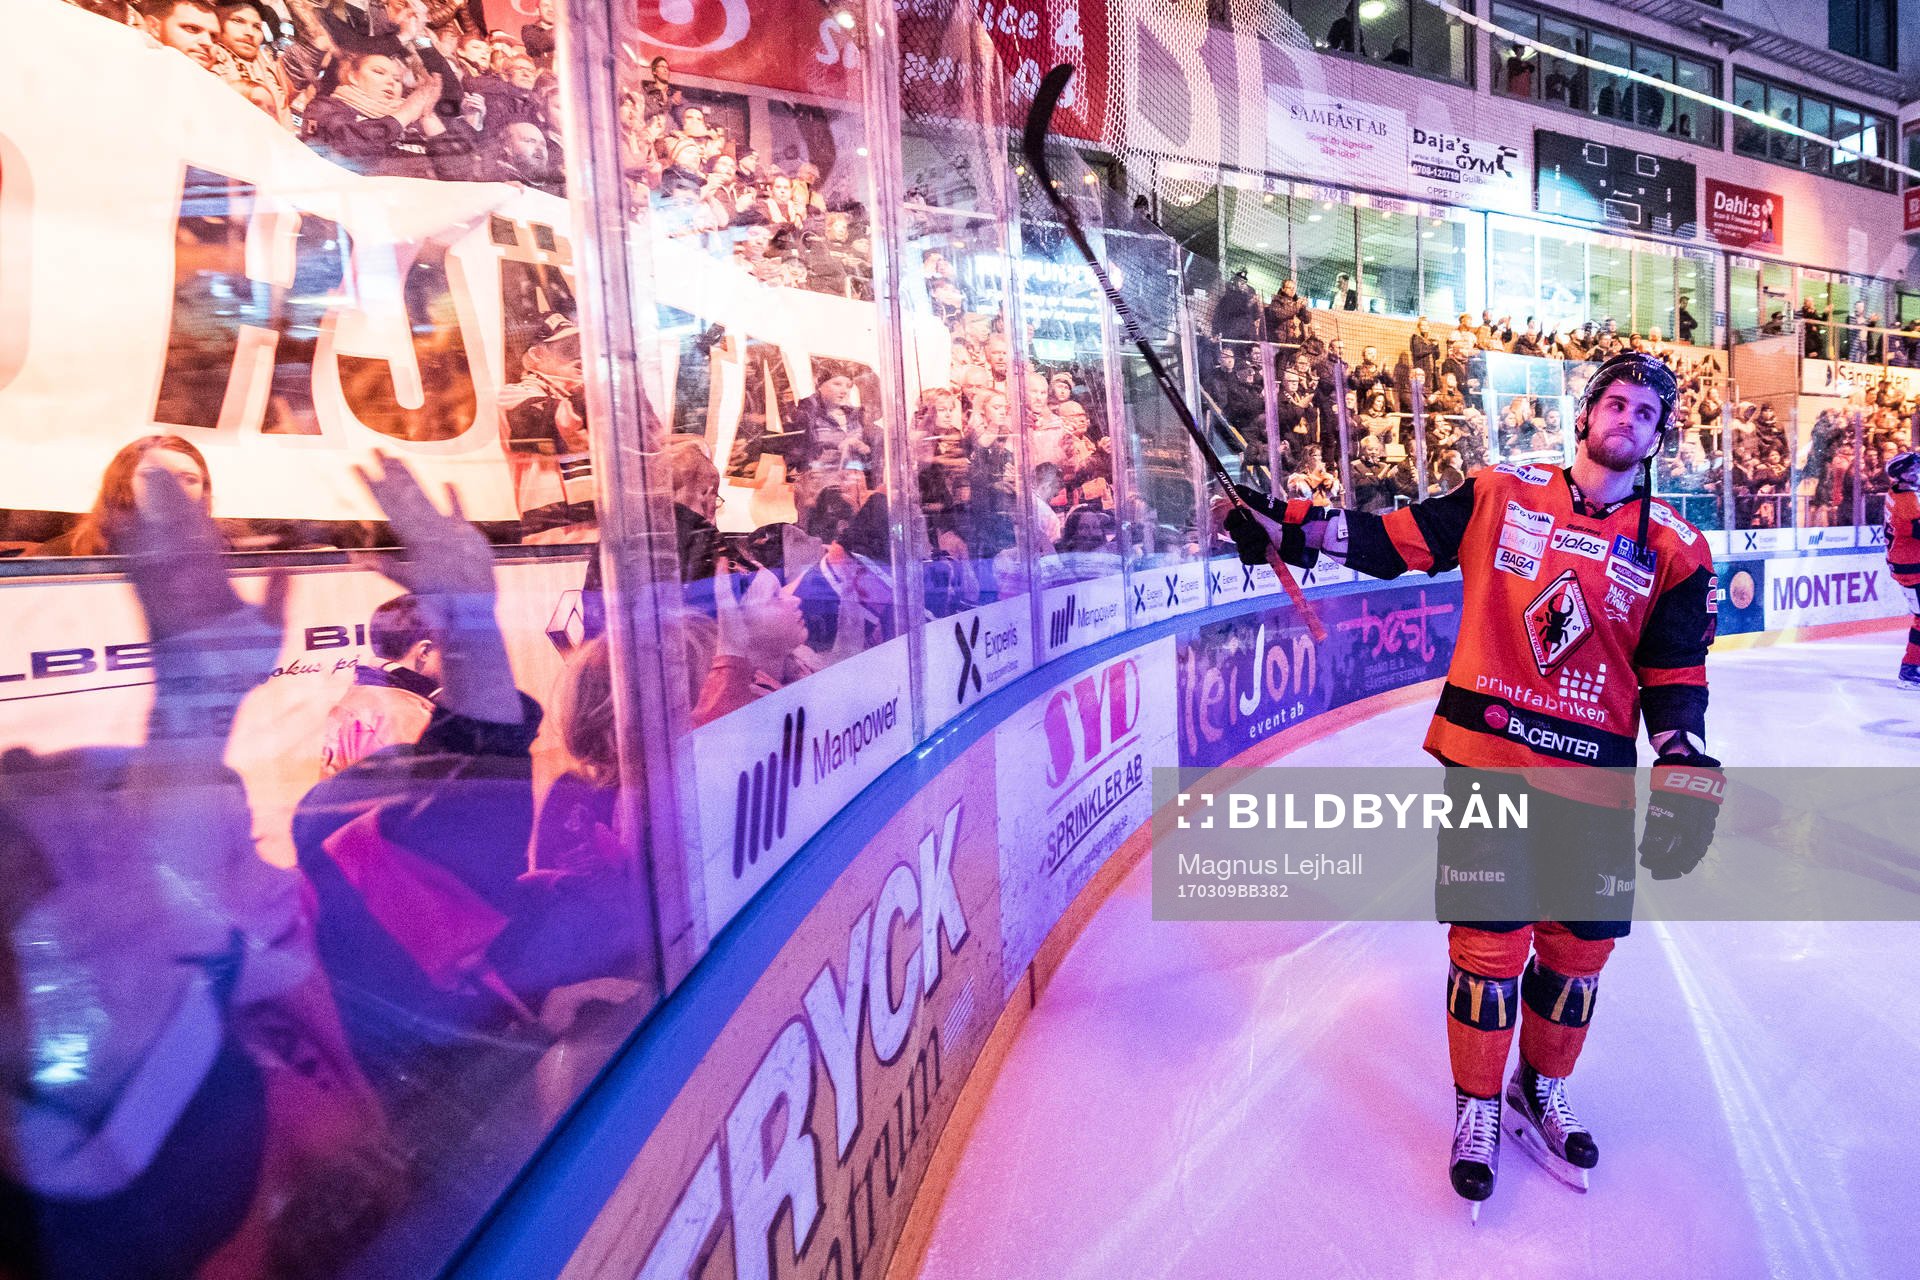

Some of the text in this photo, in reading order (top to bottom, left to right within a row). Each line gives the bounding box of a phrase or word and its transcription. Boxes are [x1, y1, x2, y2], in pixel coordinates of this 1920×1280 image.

[1456, 154, 1495, 175] GYM
[1500, 550, 1535, 571] BAGA
[1773, 570, 1879, 611] MONTEX
[304, 623, 366, 651] BI
[271, 656, 322, 678] okus
[1476, 674, 1606, 724] printfabriken
[1250, 701, 1305, 739] event ab
[813, 696, 898, 785] Manpower
[1664, 772, 1728, 797] BAU
[1047, 753, 1143, 869] SPRINKLER AB
[1450, 869, 1506, 883] Roxtec
[1616, 878, 1637, 893] Rox
